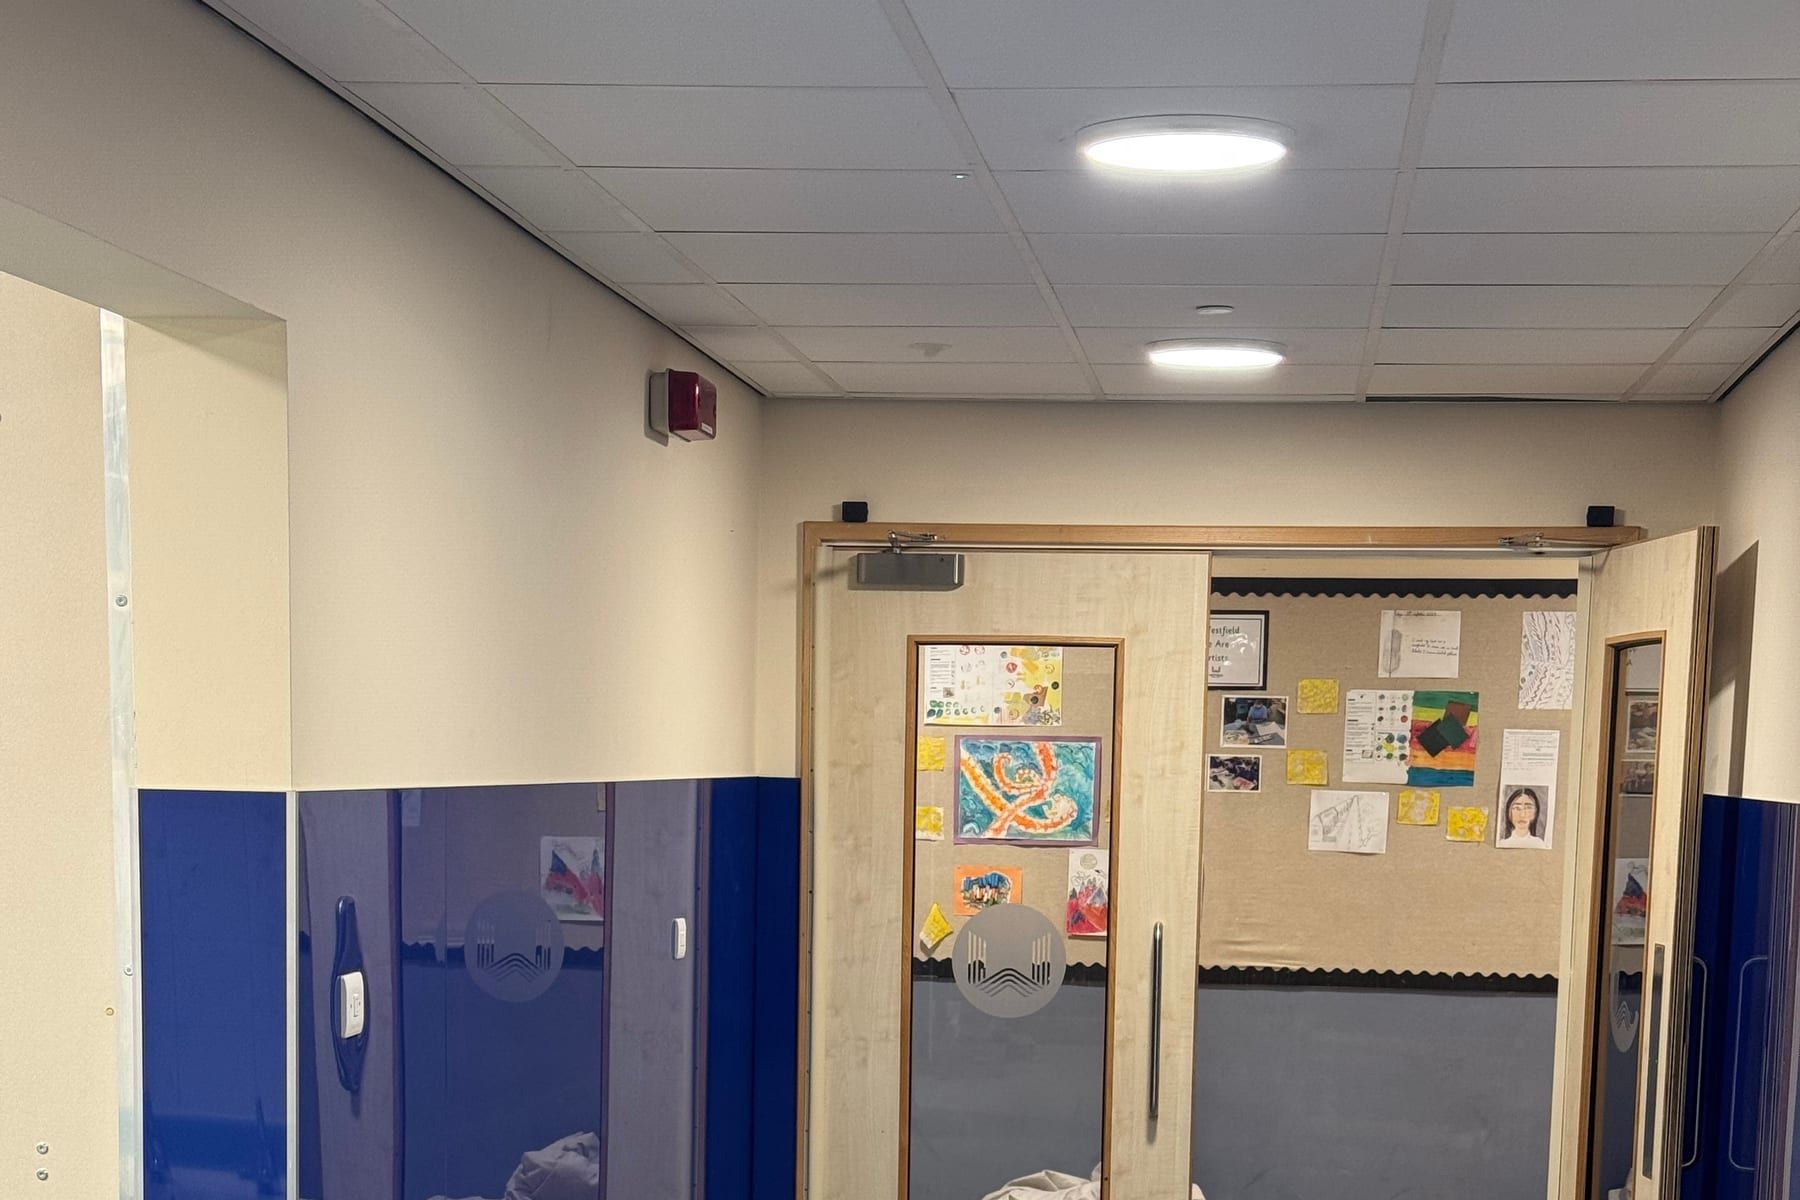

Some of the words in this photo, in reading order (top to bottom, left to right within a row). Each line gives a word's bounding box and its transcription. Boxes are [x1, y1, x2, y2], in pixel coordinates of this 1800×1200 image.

[1209, 626, 1240, 636] estfield
[1215, 640, 1229, 648] Are
[1208, 654, 1229, 662] rtists
